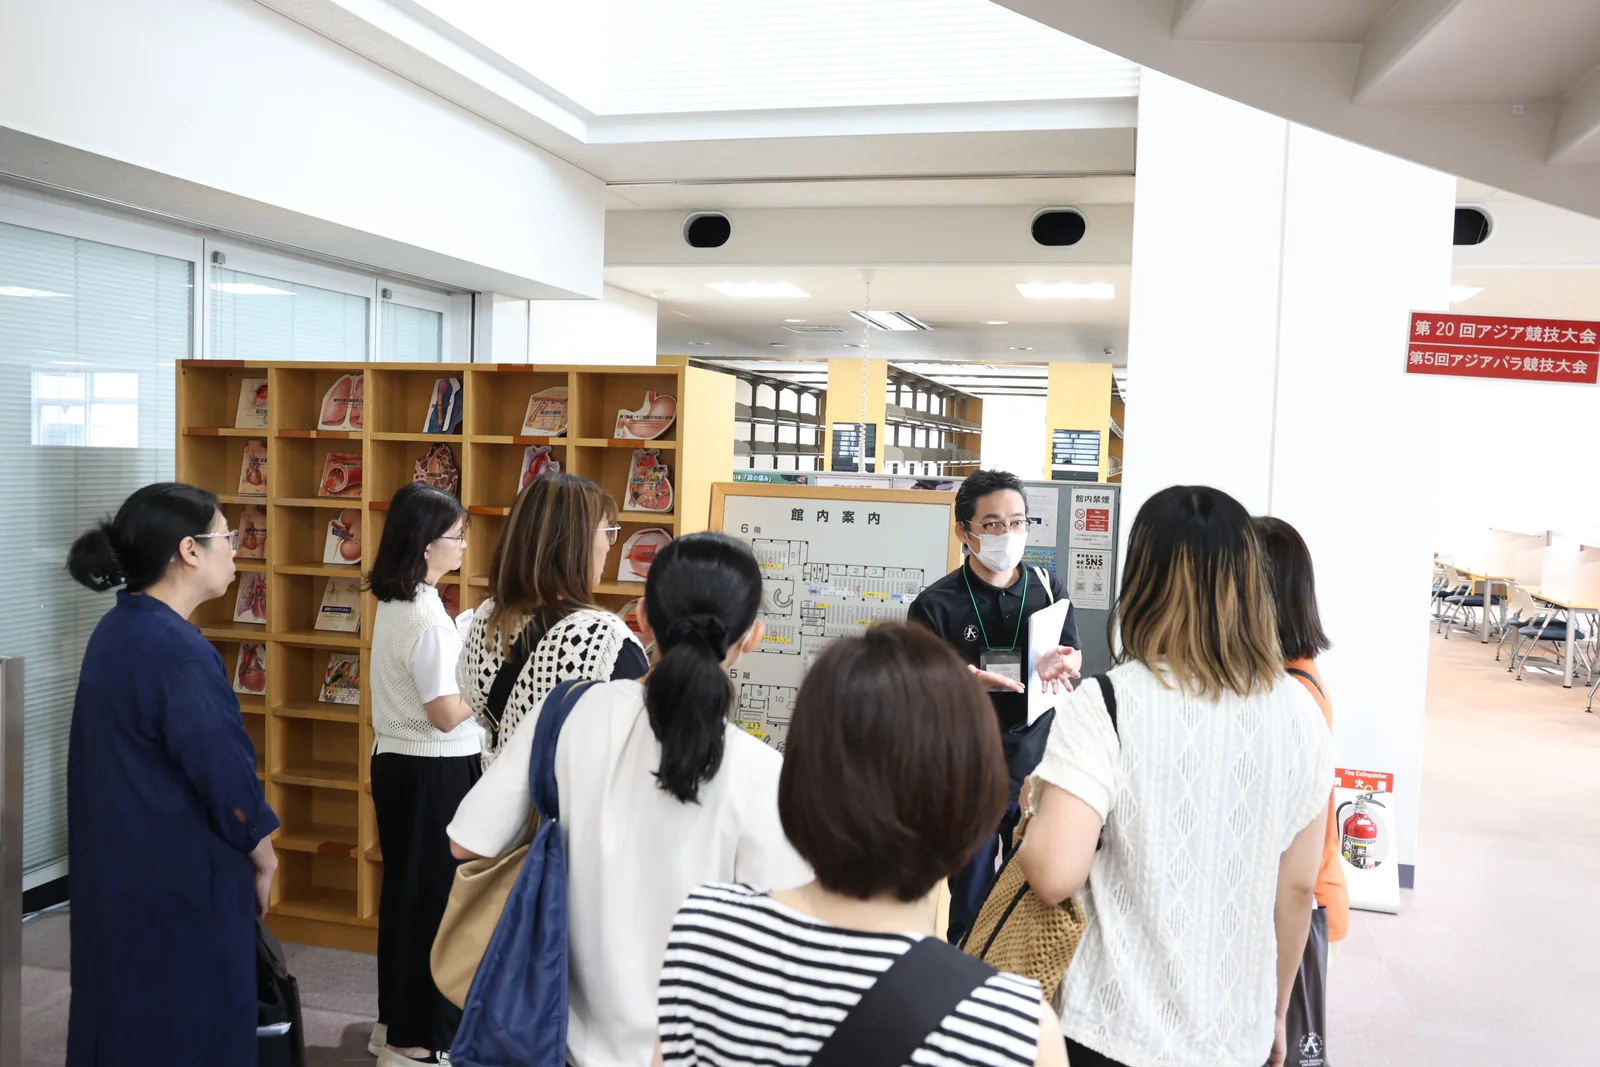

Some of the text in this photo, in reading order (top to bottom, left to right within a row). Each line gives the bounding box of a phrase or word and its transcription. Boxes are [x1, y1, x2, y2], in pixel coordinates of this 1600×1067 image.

[1415, 320, 1597, 344] 第20回アジア競技大会
[1409, 350, 1588, 374] 第5回アジアパラ競技大会
[1075, 494, 1110, 504] 館内禁煙
[791, 508, 880, 525] 館内案内
[1356, 770, 1387, 778] Extinguisher
